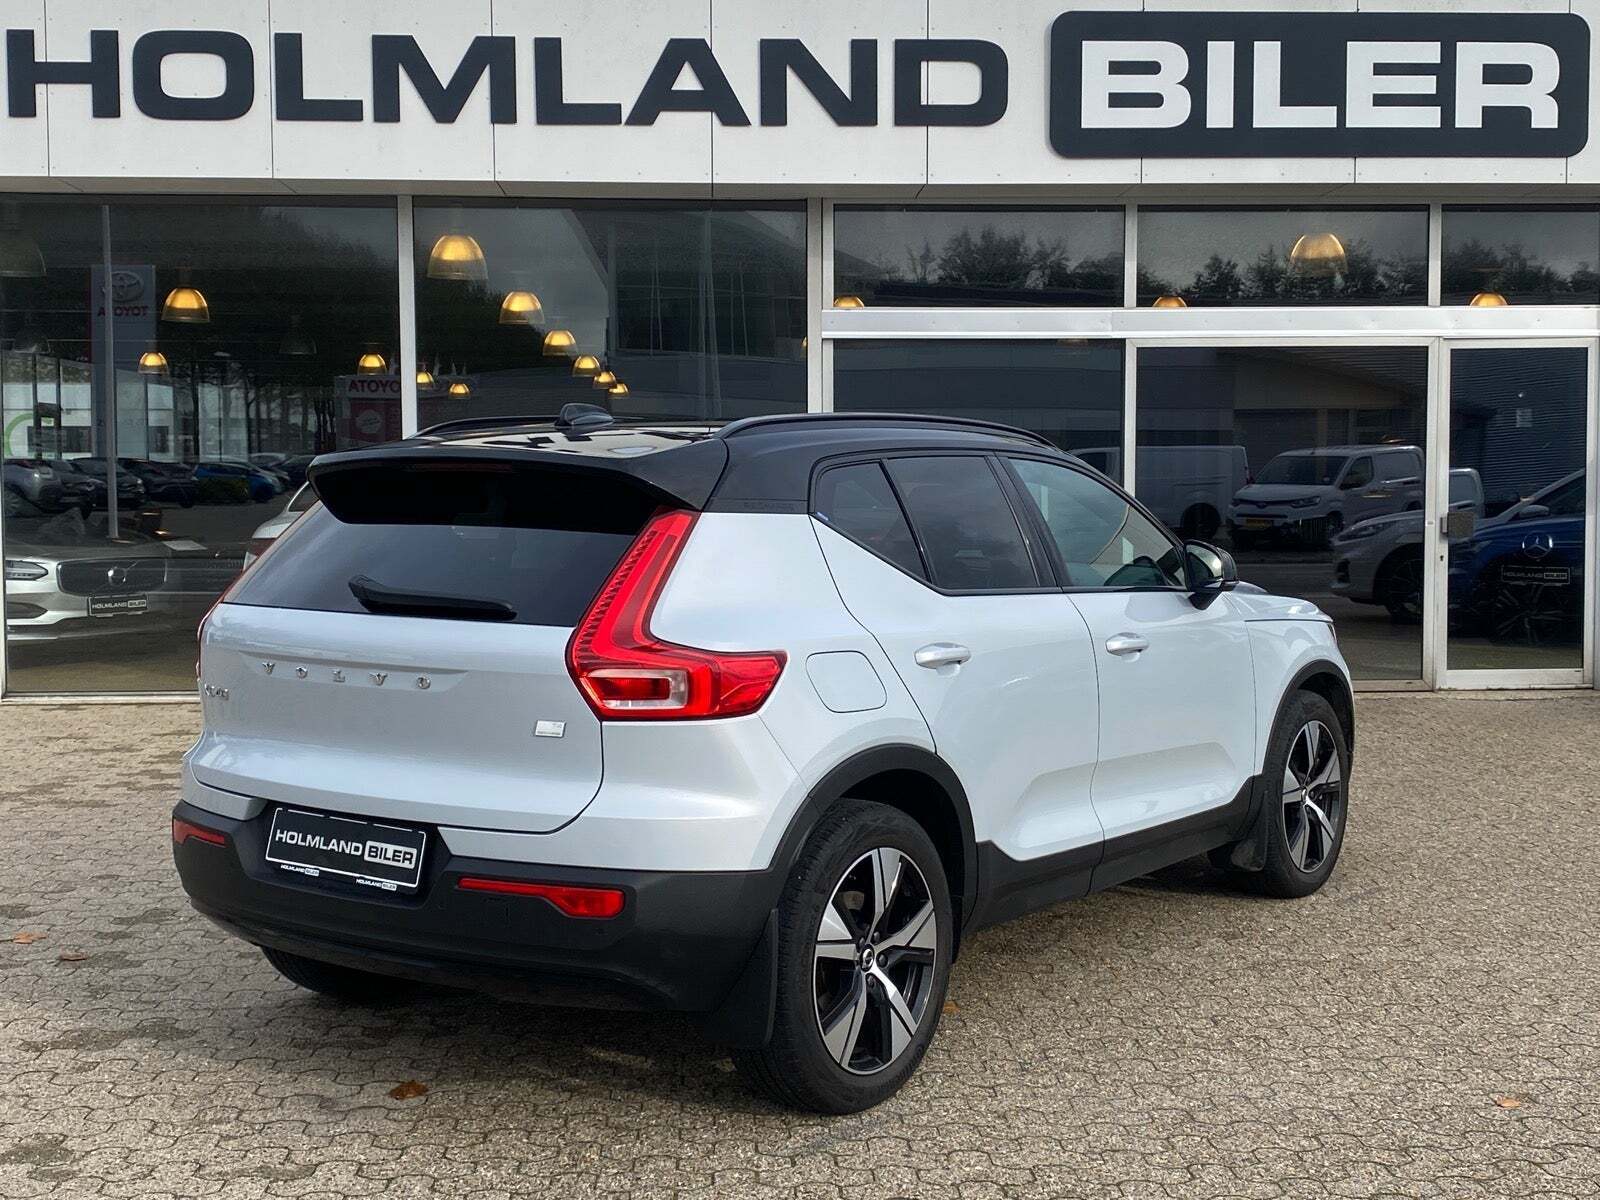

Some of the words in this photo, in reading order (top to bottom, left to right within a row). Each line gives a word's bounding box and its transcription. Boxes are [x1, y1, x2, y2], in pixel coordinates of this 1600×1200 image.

[6, 29, 1009, 127] HOLMLAND
[1080, 40, 1560, 130] BILER
[262, 661, 432, 690] VOLVO
[275, 829, 363, 856] HOLMLAND
[367, 845, 414, 865] BILER
[356, 878, 382, 887] HOLMLAND
